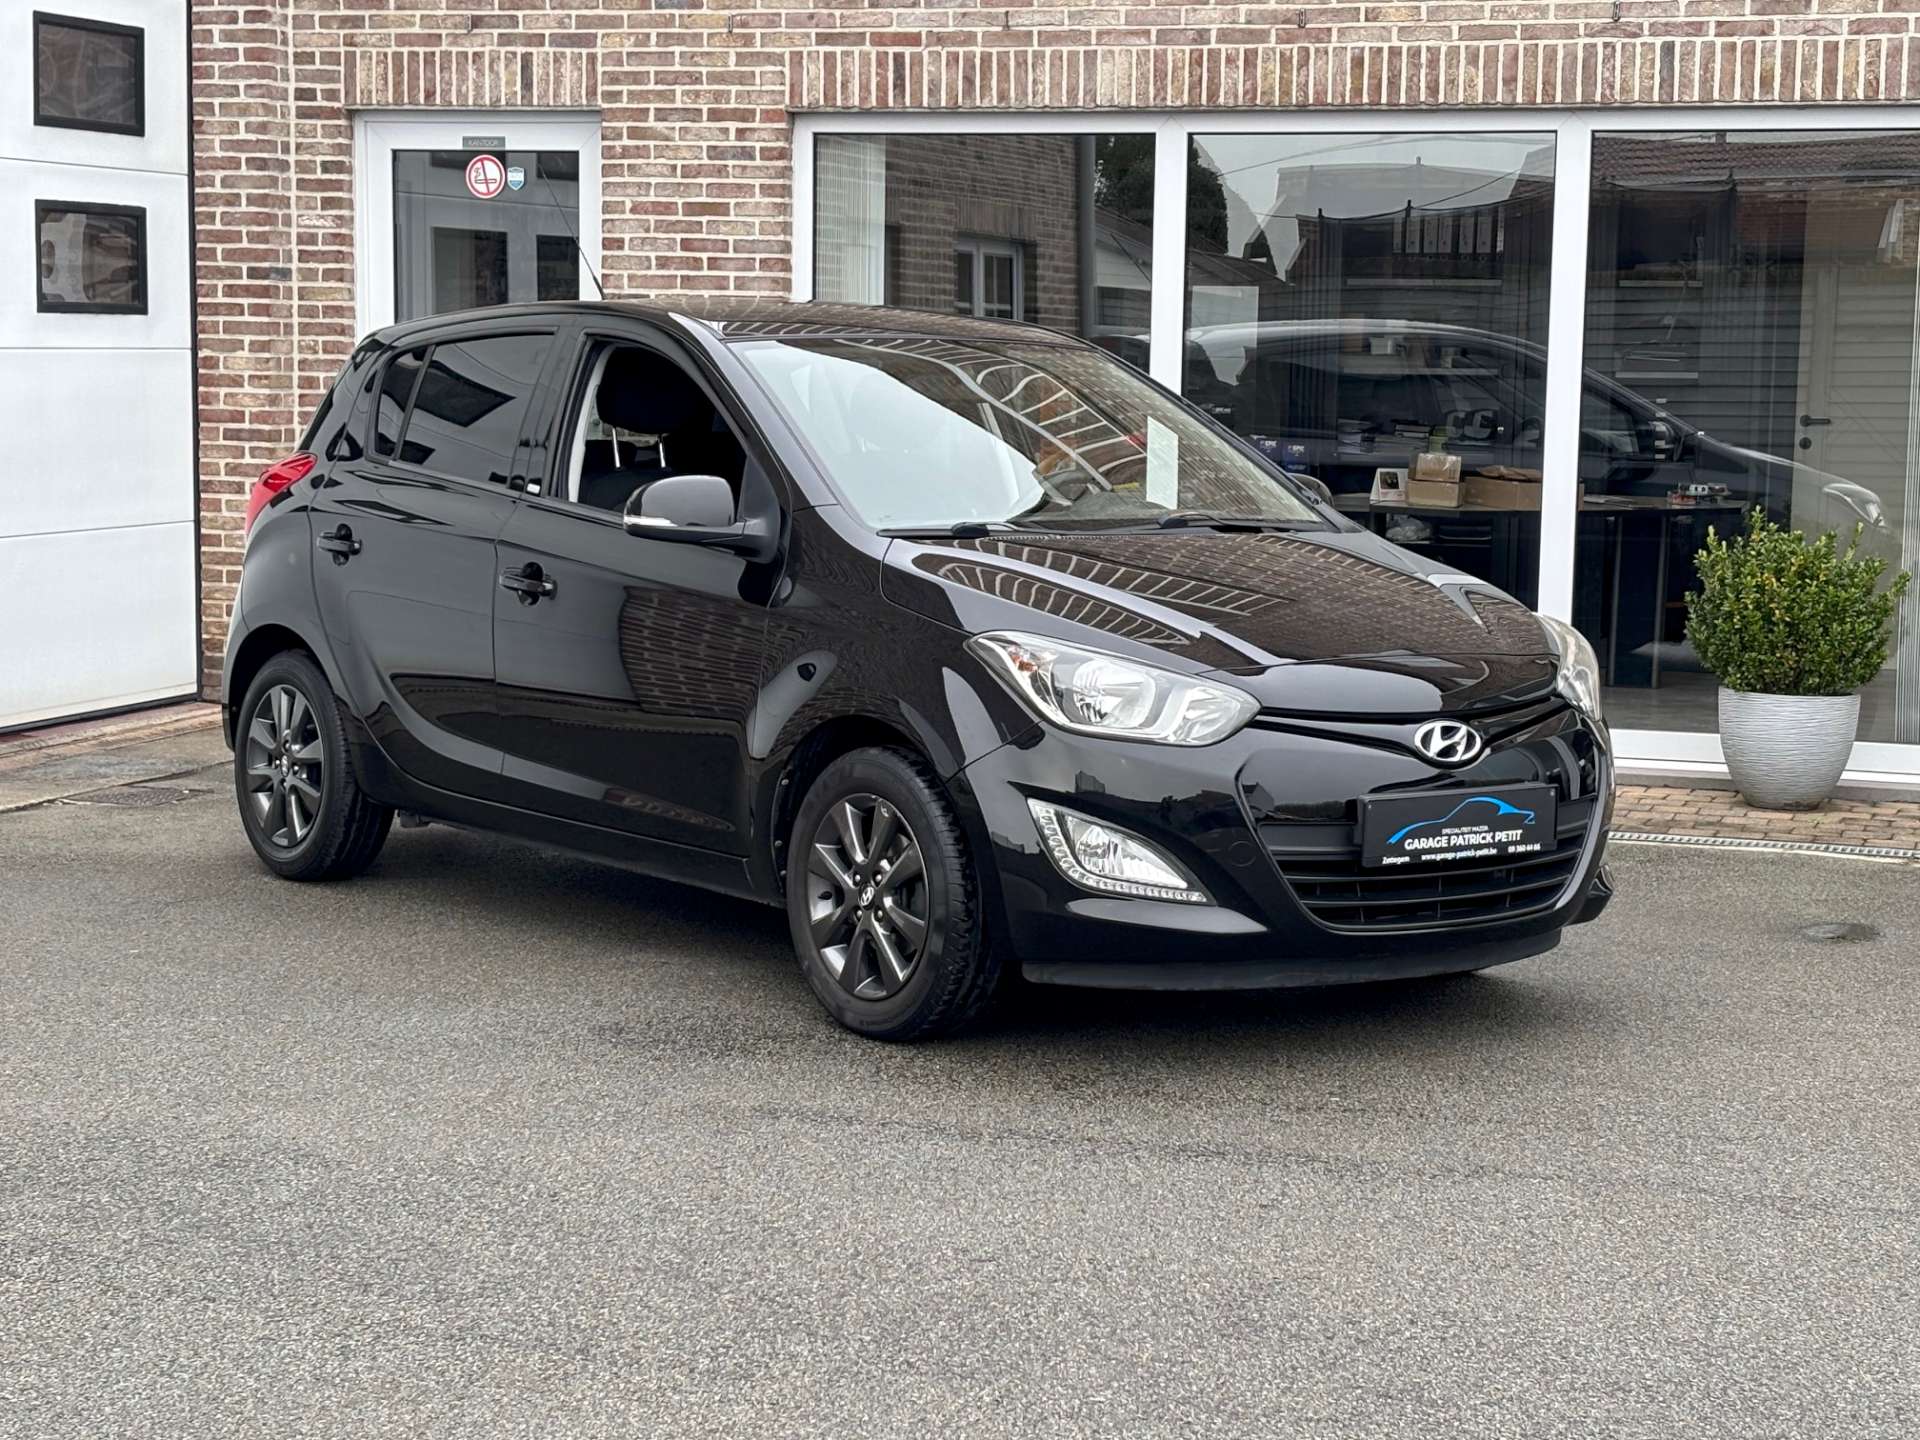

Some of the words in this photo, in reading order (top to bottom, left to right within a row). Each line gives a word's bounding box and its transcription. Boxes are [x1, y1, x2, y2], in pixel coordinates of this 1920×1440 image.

[1404, 835, 1449, 850] GARAGE
[1450, 831, 1494, 847] PATRICK
[1495, 829, 1523, 843] PETIT
